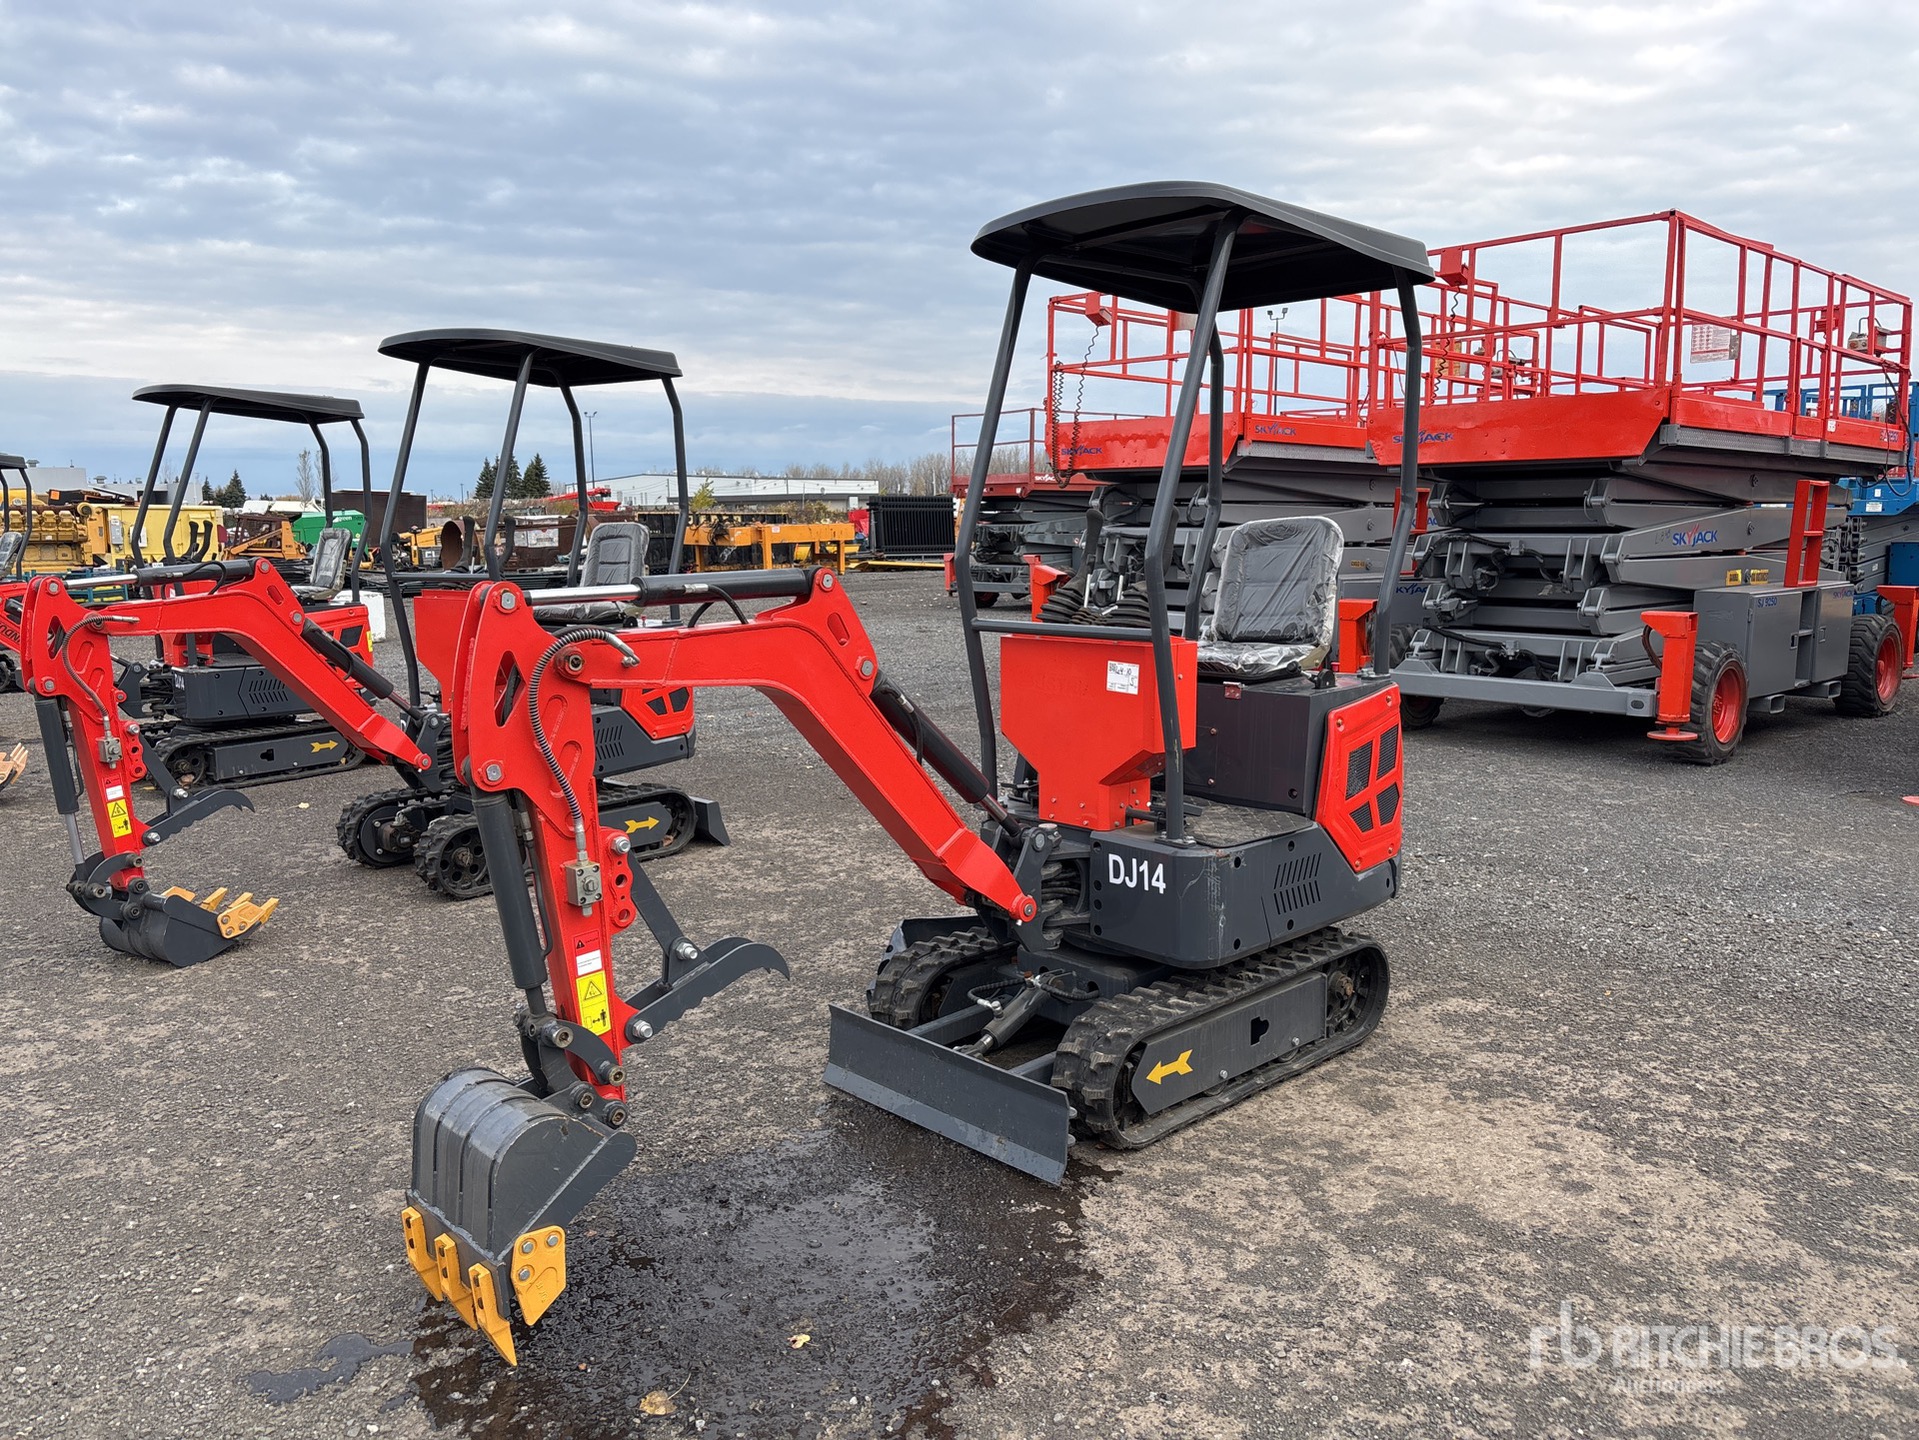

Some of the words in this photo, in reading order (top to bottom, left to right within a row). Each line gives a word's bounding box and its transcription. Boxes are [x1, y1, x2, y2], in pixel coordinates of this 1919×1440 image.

[1255, 421, 1297, 436] SKYJACK
[1393, 430, 1454, 444] SJACK
[1672, 523, 1718, 547] SKYJACK
[1108, 853, 1167, 895] DJ14
